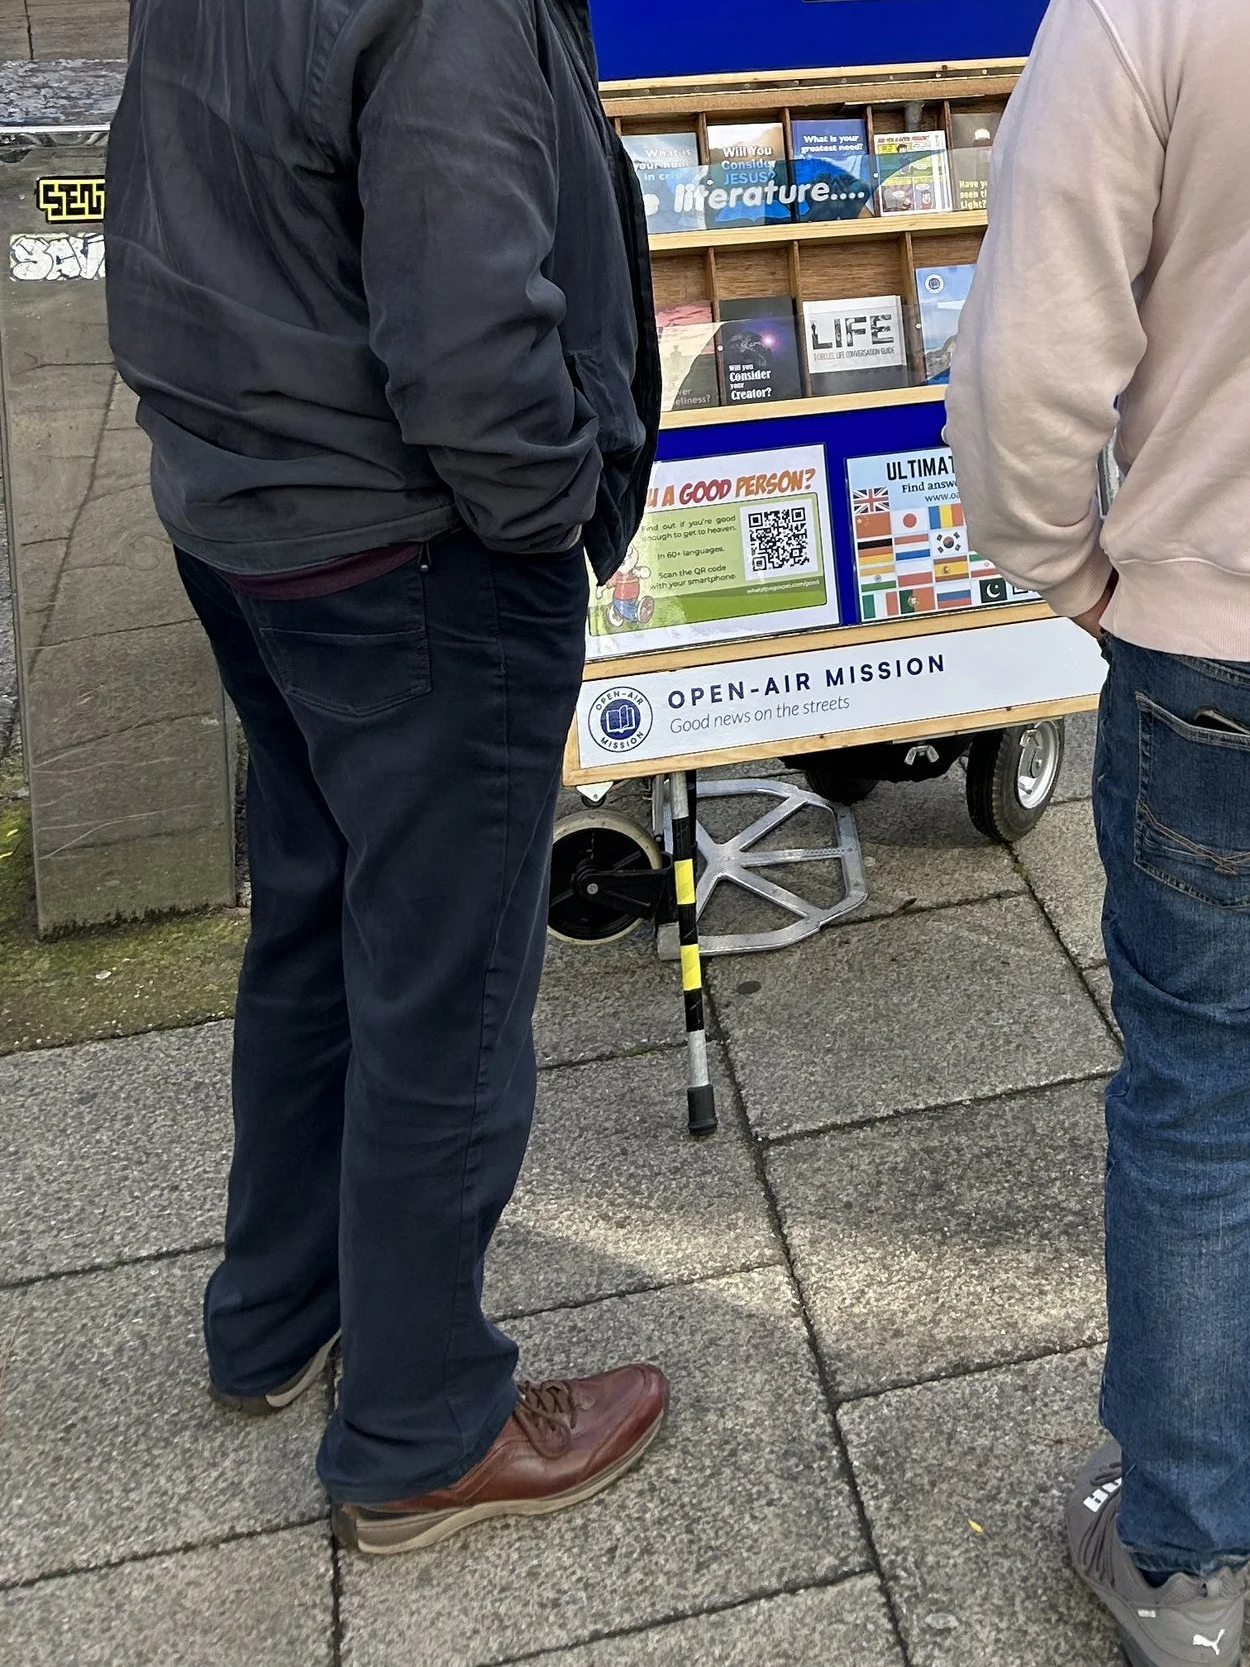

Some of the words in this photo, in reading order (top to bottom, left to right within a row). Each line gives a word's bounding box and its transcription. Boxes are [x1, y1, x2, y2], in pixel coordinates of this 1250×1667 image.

[803, 135, 828, 144] What
[829, 135, 837, 143] is
[838, 135, 860, 145] your
[644, 148, 678, 158] What
[723, 146, 746, 158] Will
[748, 145, 773, 157] You
[800, 143, 838, 154] greatest
[838, 142, 864, 152] need?
[721, 159, 777, 171] Consider
[644, 171, 655, 182] in
[723, 168, 777, 185] JESUS?
[959, 180, 979, 188] Have
[980, 180, 988, 189] y
[960, 190, 979, 199] seen
[960, 199, 987, 210] Light?
[811, 314, 894, 350] LIFE
[729, 369, 772, 381] Consider
[730, 382, 744, 390] your
[731, 386, 772, 402] Creator?
[661, 484, 675, 507] A
[679, 478, 732, 505] GOOD
[735, 467, 817, 499] PERSON?
[901, 481, 925, 494] Find
[662, 522, 676, 530] out
[688, 518, 712, 528] you're
[715, 515, 736, 524] good
[683, 529, 696, 538] get
[707, 525, 737, 534] heaven.
[666, 551, 681, 559] 60+
[658, 571, 677, 579] Scan
[694, 566, 706, 575] QR
[707, 564, 727, 573] code
[650, 582, 667, 590] with
[668, 579, 686, 590] your
[668, 672, 811, 710] OPEN-AIR
[825, 654, 945, 687] MISSION
[595, 690, 644, 711] OPEN-AIR
[669, 711, 710, 735] Good
[713, 710, 751, 727] news
[754, 707, 773, 722] on
[776, 700, 800, 719] the
[802, 694, 850, 716] streets
[600, 730, 644, 750] MISSION
